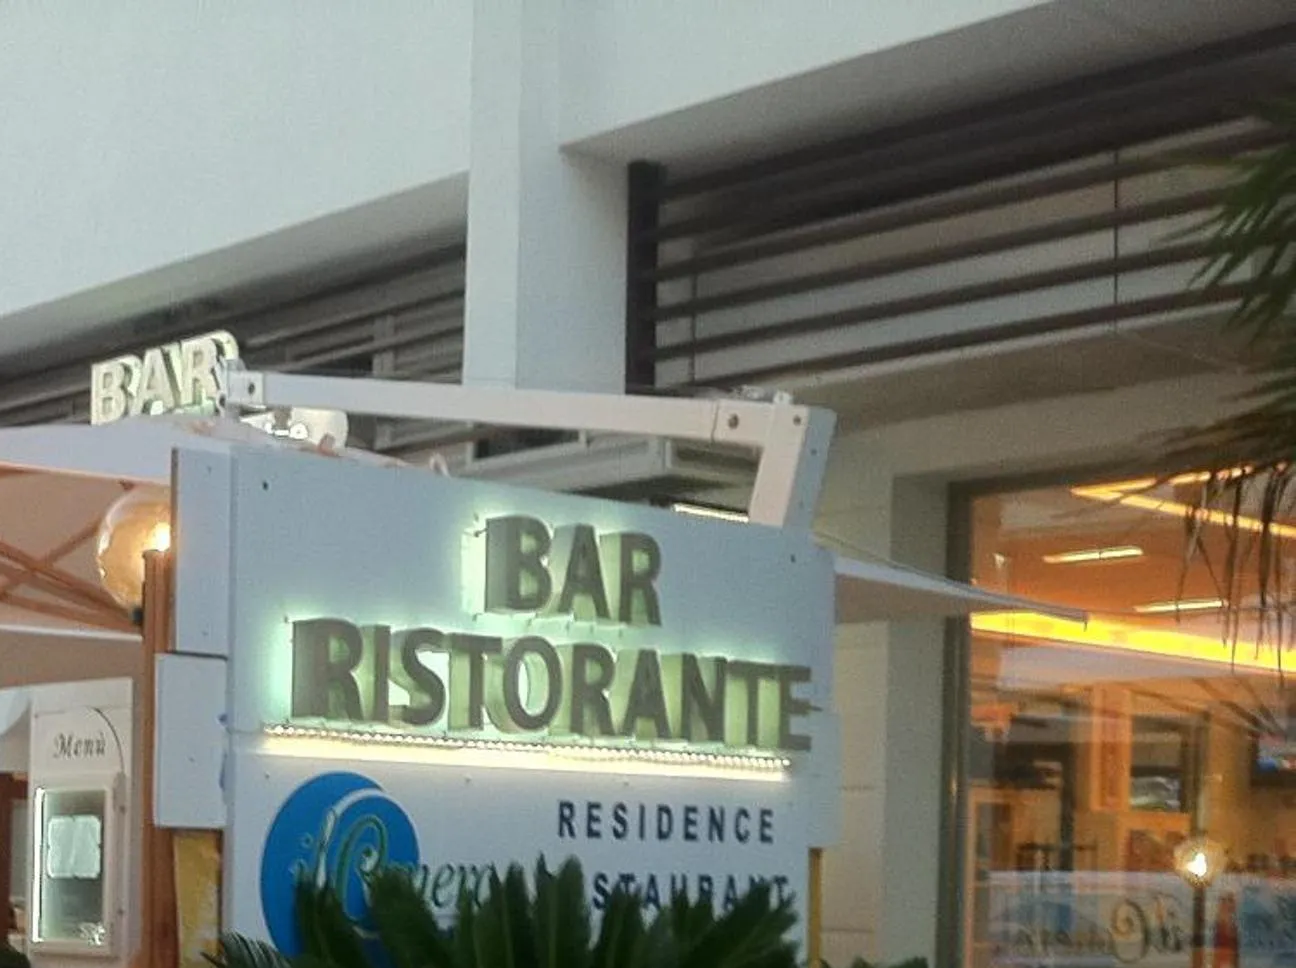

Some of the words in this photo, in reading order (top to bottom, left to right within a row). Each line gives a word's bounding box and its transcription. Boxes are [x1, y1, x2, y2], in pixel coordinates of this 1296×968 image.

[90, 330, 240, 426] BAR
[484, 513, 662, 627] BAR
[291, 617, 812, 752] RISTORANTE
[557, 799, 776, 845] RESIDENCE
